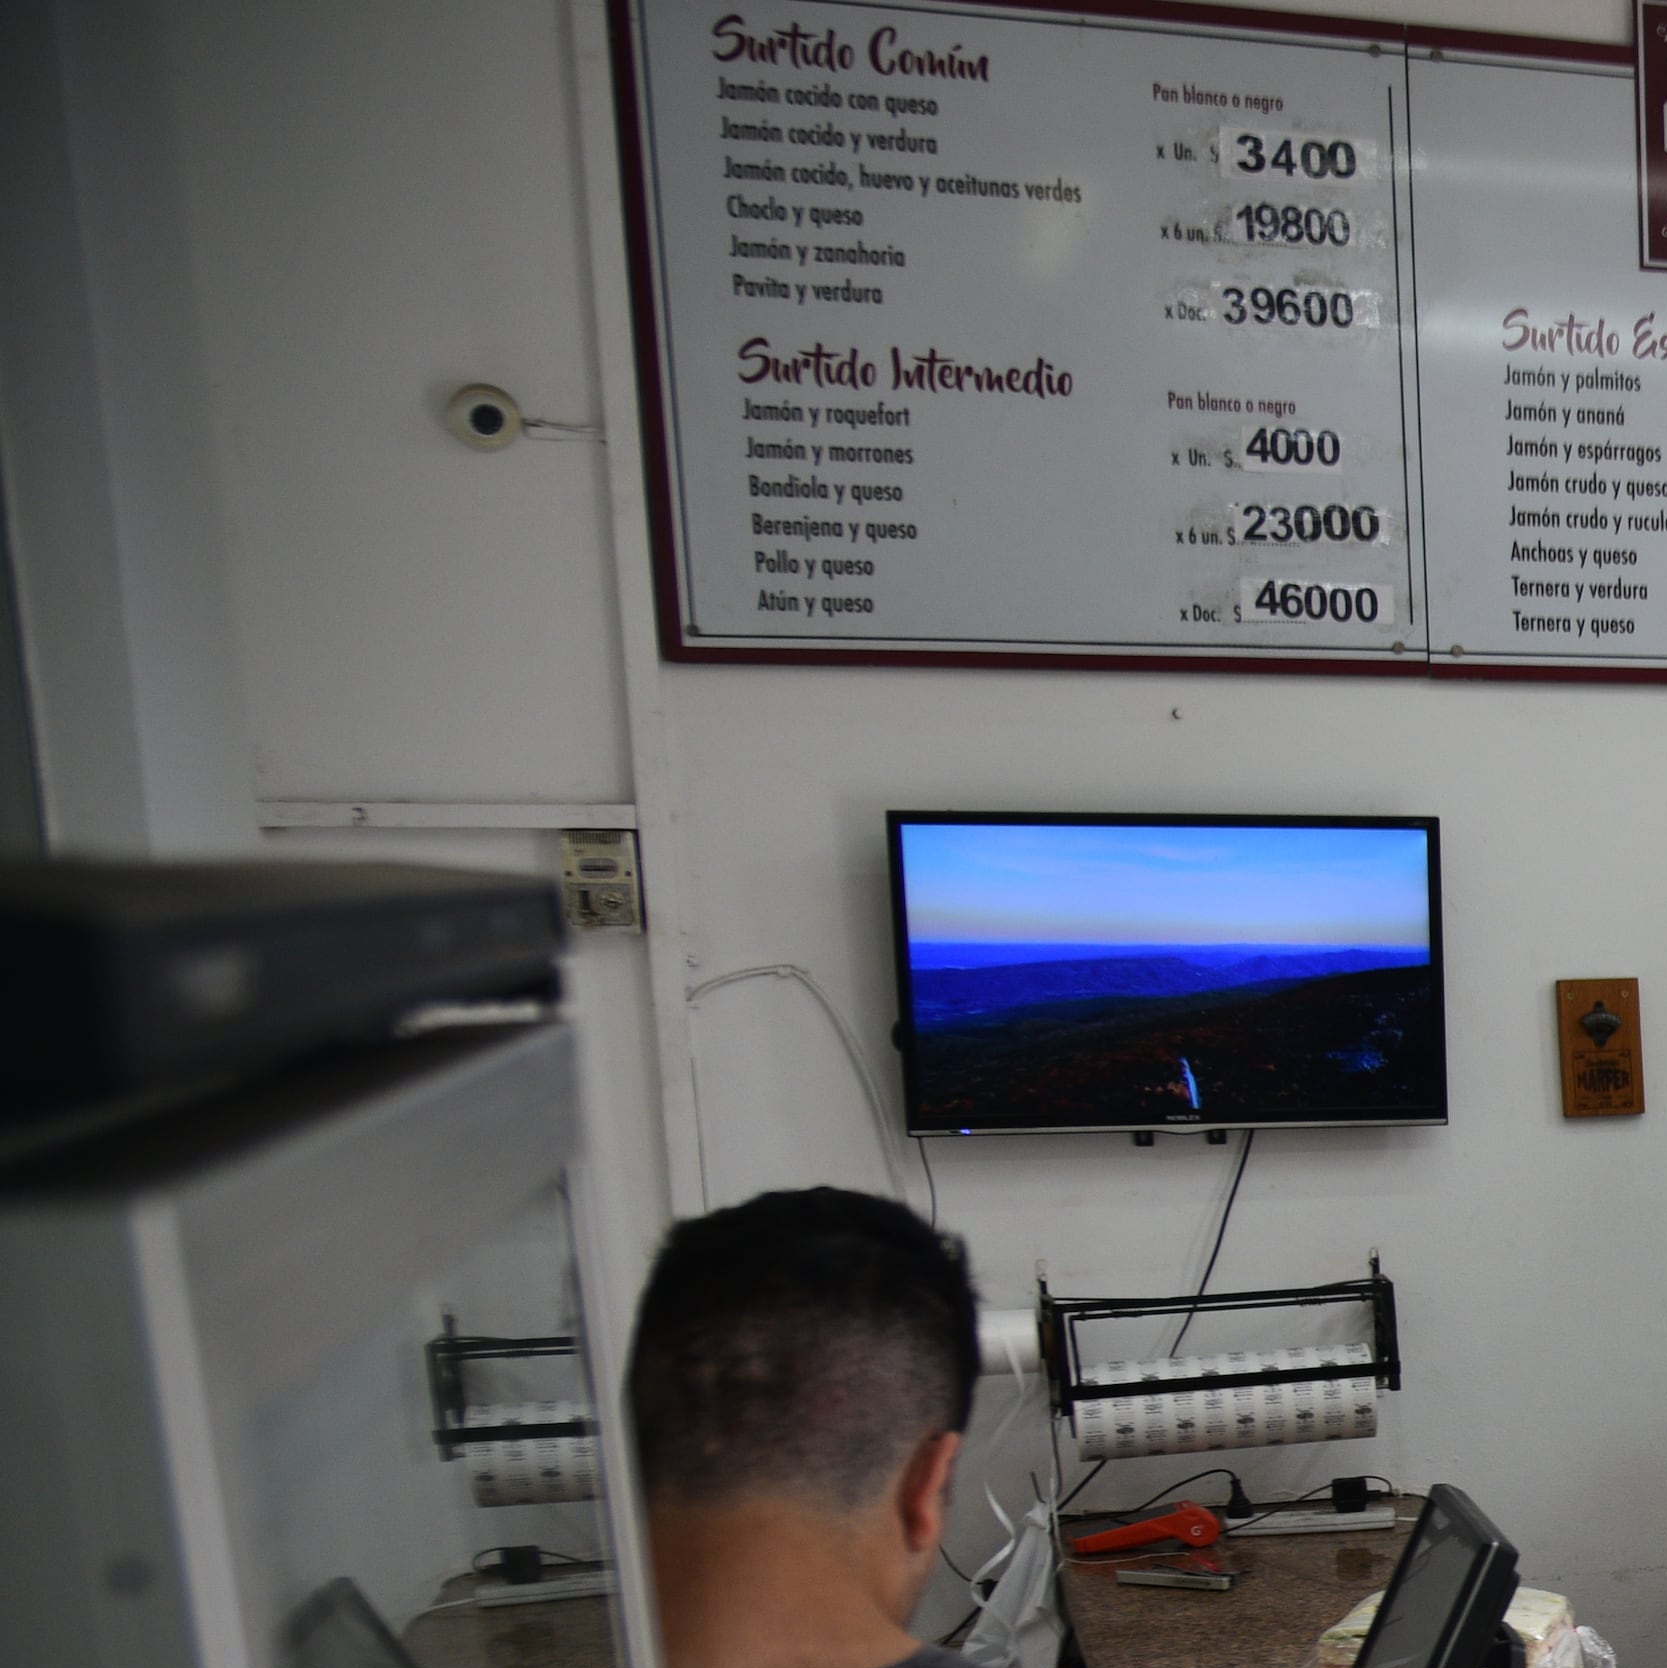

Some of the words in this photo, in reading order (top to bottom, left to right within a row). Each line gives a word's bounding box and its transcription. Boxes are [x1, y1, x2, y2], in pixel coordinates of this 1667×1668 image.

[711, 13, 854, 73] Surtido
[867, 26, 989, 83] Común
[716, 76, 781, 103] Jamón
[784, 82, 843, 109] cocido
[847, 92, 880, 111] con
[884, 95, 939, 119] queso
[1152, 81, 1179, 103] Pan
[1182, 84, 1228, 108] blanco
[1231, 93, 1241, 109] o
[1244, 95, 1284, 115] negro
[719, 115, 783, 143] Jamón
[787, 121, 846, 148] cocido
[849, 131, 863, 154] y
[865, 127, 938, 155] verdura
[1236, 133, 1356, 179] 3400
[722, 155, 786, 182] Jamón
[790, 160, 854, 191] cocido,
[858, 164, 915, 192] huevo
[918, 175, 931, 198] y
[935, 173, 1020, 199] aceitunas
[1023, 177, 1082, 204] verdes
[725, 193, 788, 222] Choclo
[791, 205, 805, 228] y
[808, 206, 864, 229] queso
[1236, 203, 1350, 247] 19800
[728, 233, 792, 260] Jamón
[795, 244, 809, 267] y
[813, 239, 906, 268] zanahoria
[732, 272, 791, 300] Pavita
[794, 283, 808, 305] y
[811, 277, 884, 305] verdura
[1222, 287, 1354, 329] 39600
[1501, 305, 1620, 357] Surtido
[737, 336, 876, 391] Surtido
[890, 346, 1073, 399] Intermedio
[1503, 363, 1556, 388] Jamón
[1560, 373, 1571, 393] y
[1575, 367, 1642, 394] palmitos
[742, 397, 804, 422] Jamón
[807, 407, 821, 429] y
[825, 400, 911, 430] roquefort
[1167, 390, 1194, 410] Pan
[1196, 391, 1242, 413] blanco
[1245, 399, 1255, 414] o
[1257, 400, 1297, 419] negro
[1505, 398, 1557, 423] Jamón
[1561, 408, 1572, 429] y
[1576, 405, 1625, 426] ananá
[745, 435, 807, 461] Jamón
[810, 445, 824, 467] y
[828, 445, 915, 465] morrones
[1245, 426, 1341, 466] 4000
[1506, 434, 1558, 458] Jamón
[1562, 443, 1573, 464] y
[1577, 439, 1662, 467] espárragos
[748, 473, 829, 500] Bondiola
[833, 483, 846, 506] y
[850, 484, 904, 506] queso
[1507, 469, 1560, 493] Jamón
[1564, 471, 1608, 495] crudo
[1611, 480, 1621, 500] y
[751, 512, 844, 542] Berenjena
[847, 522, 860, 544] y
[864, 522, 918, 544] queso
[1242, 503, 1380, 542] 23000
[1508, 504, 1561, 528] Jamón
[1565, 506, 1609, 530] crudo
[1612, 515, 1623, 535] y
[754, 549, 801, 575] Pollo
[804, 558, 817, 580] y
[821, 558, 875, 581] queso
[1510, 539, 1574, 564] Anchoas
[1578, 548, 1588, 569] y
[1592, 548, 1638, 569] queso
[757, 589, 800, 612] Atún
[803, 596, 816, 618] y
[820, 596, 875, 618] queso
[1254, 579, 1379, 622] 46000
[1510, 574, 1570, 598] Ternera
[1574, 583, 1585, 603] y
[1588, 576, 1648, 600] verdura
[1512, 609, 1572, 633] Ternera
[1575, 618, 1586, 638] y
[1590, 618, 1635, 639] queso
